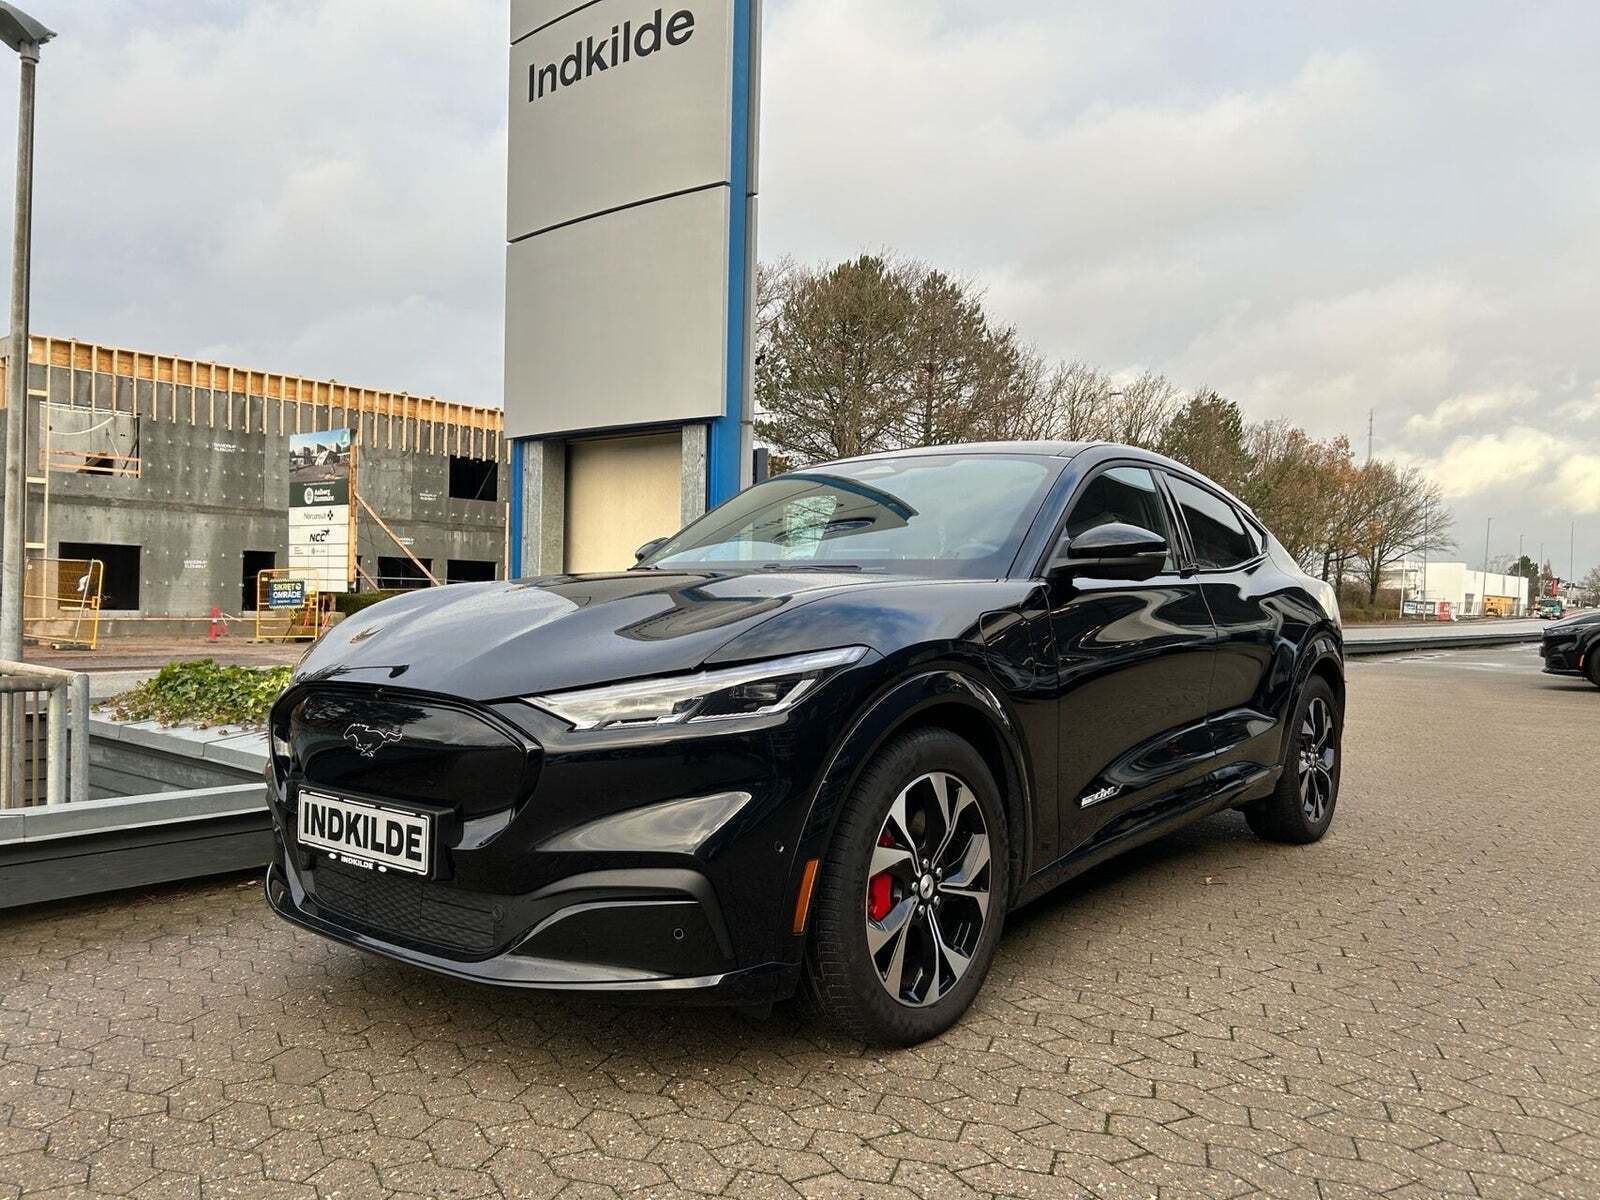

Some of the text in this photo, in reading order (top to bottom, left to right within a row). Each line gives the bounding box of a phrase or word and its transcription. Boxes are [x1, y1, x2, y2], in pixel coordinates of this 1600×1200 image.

[528, 8, 695, 103] Indkilde
[309, 533, 326, 542] NCC
[273, 583, 295, 591] SIKRET
[272, 590, 302, 599] OMRÅDE
[303, 801, 422, 862] INDKILDE
[340, 855, 374, 870] INDKILDE
